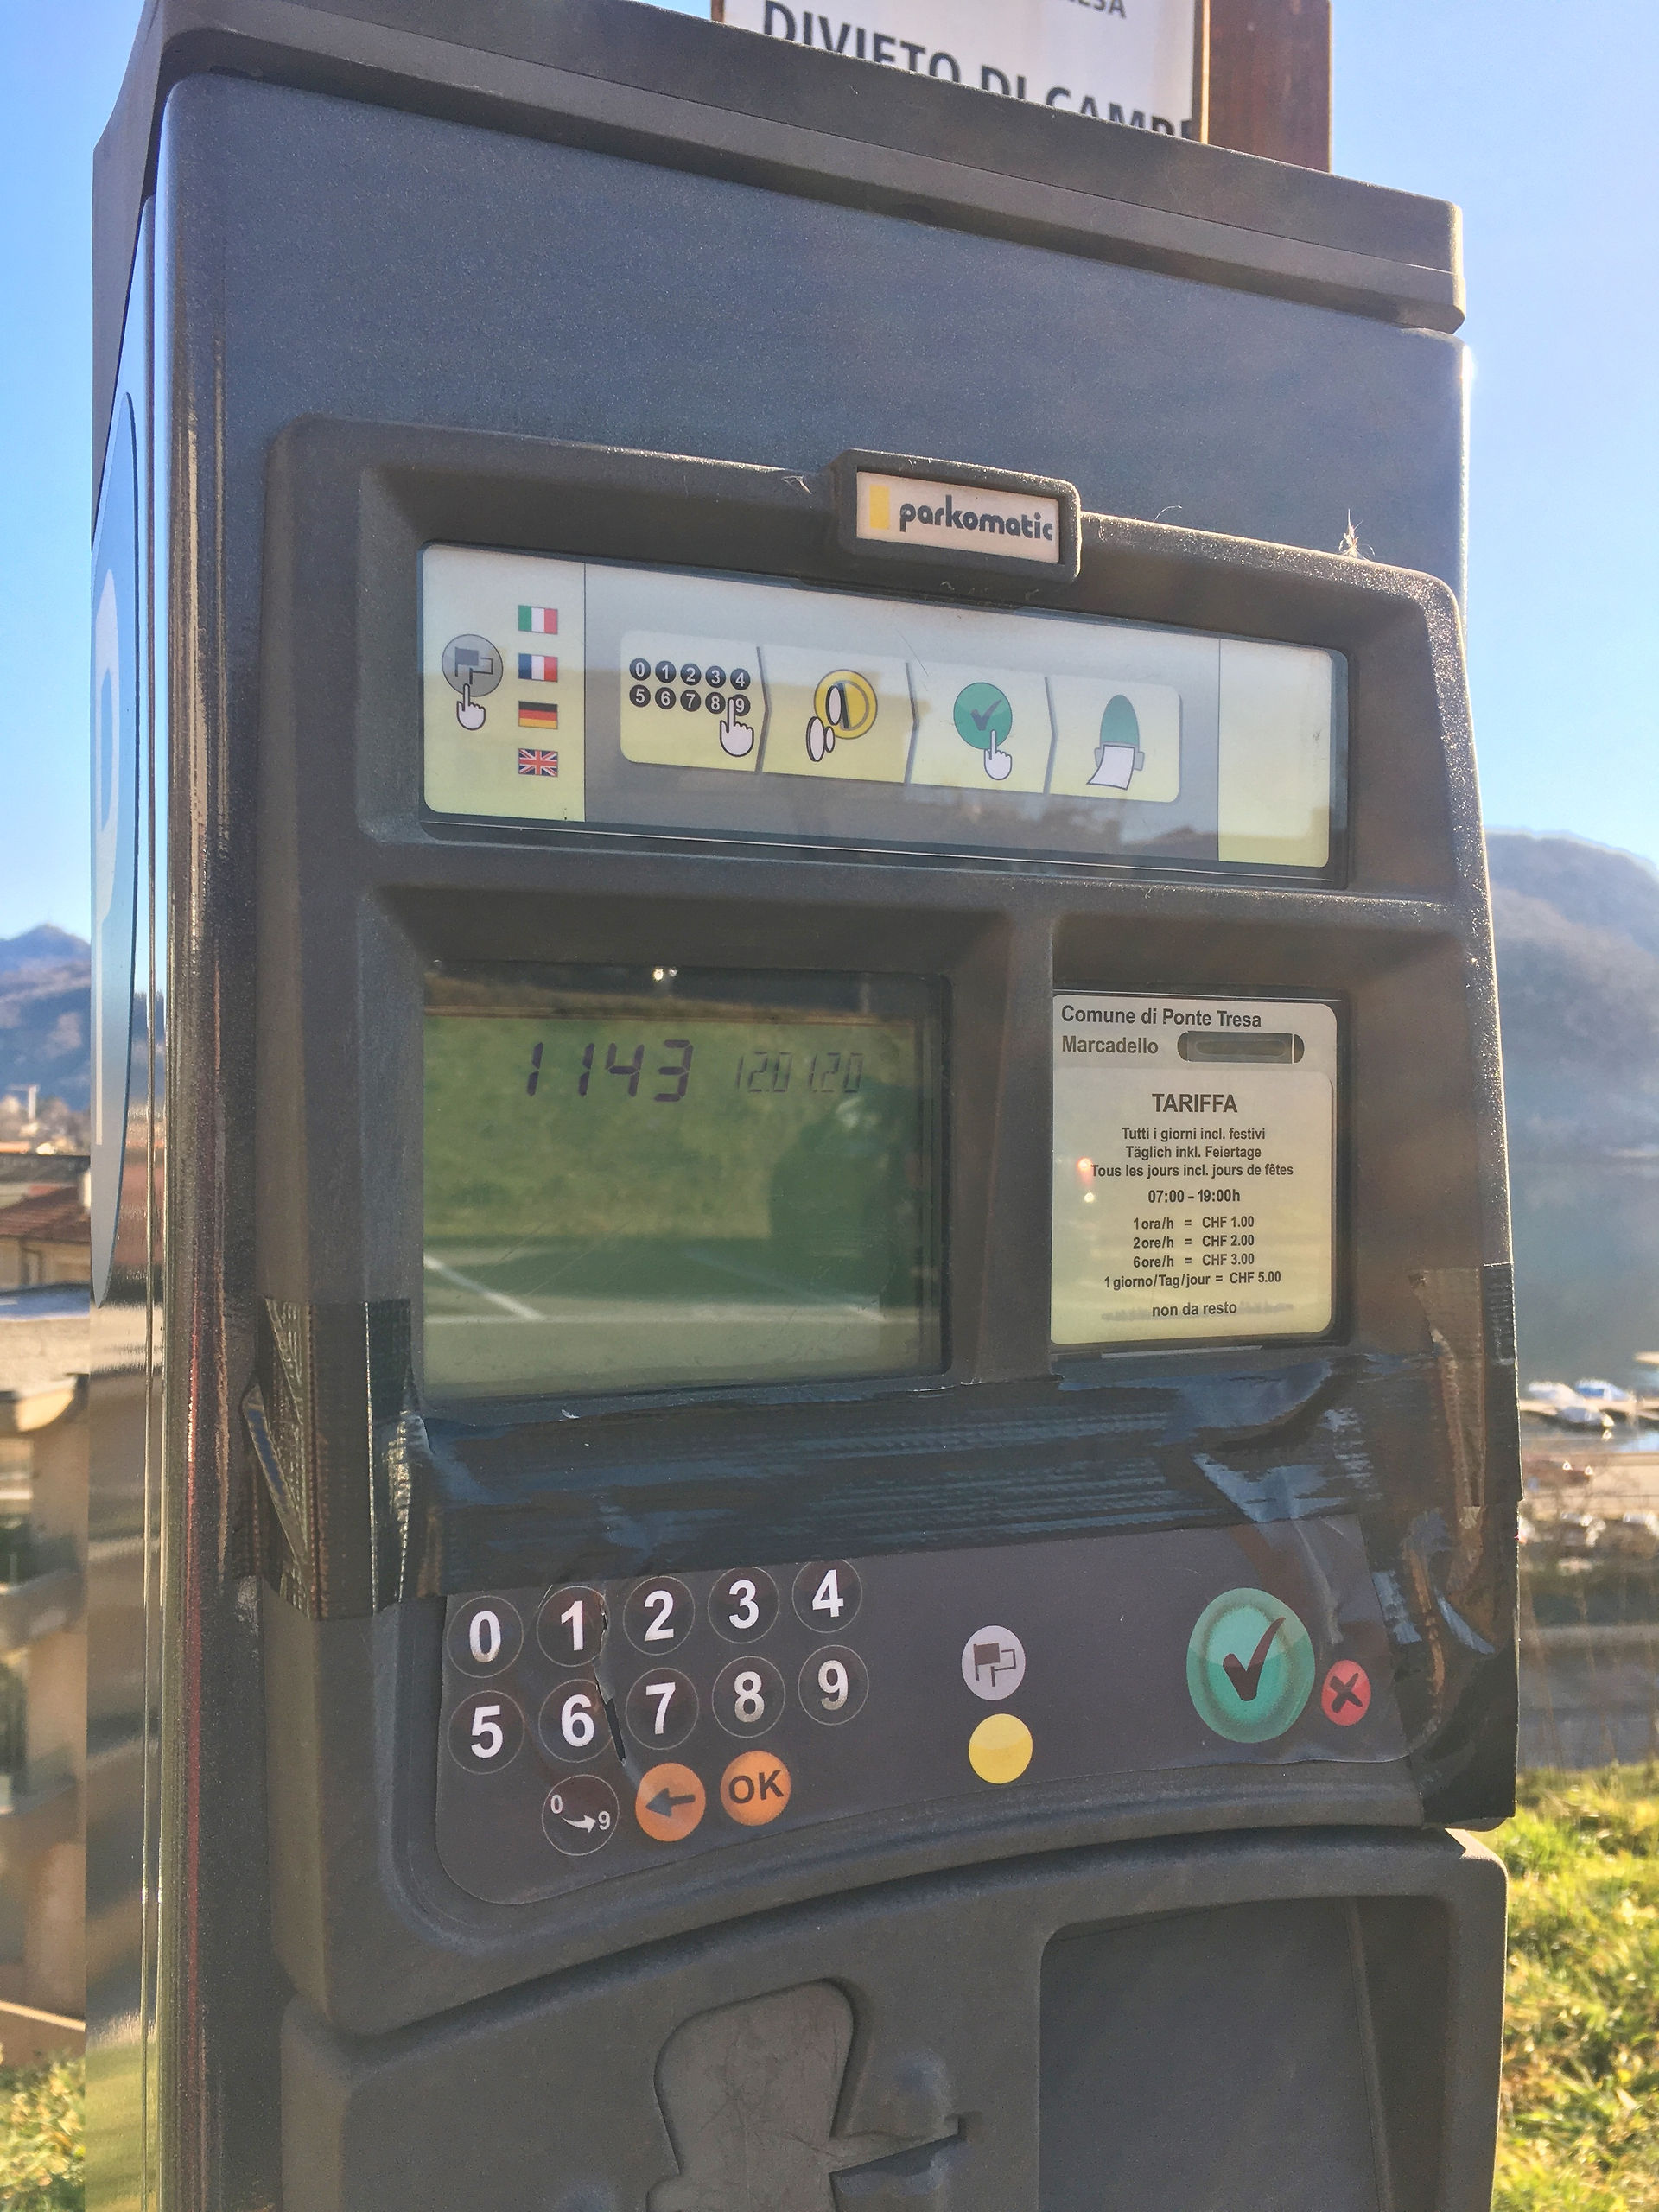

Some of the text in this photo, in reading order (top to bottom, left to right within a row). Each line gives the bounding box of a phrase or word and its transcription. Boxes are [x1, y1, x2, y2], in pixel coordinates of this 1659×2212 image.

[899, 494, 1052, 541] parkomatic
[635, 662, 745, 687] 0 1 2 3 4
[635, 689, 745, 713] 5 6 7 8 9
[1061, 1005, 1262, 1027] Comune di Ponte Tresa
[1062, 1035, 1159, 1054] Marcadello
[1152, 1093, 1238, 1113] TARIFFA
[1122, 1128, 1265, 1142] Tutti i giorni incl. festivi
[1126, 1146, 1262, 1160] Täglich inkl. Feiertage
[1091, 1163, 1294, 1179] Tous les jours incl. jours de fêtes
[1147, 1190, 1185, 1203] 07:00
[1202, 1216, 1227, 1228] CHF
[1230, 1216, 1255, 1228] 1.00
[1202, 1235, 1227, 1247] CHF
[1230, 1234, 1255, 1246] 2.00
[1202, 1254, 1227, 1266] CHF
[1230, 1253, 1255, 1265] 3.00
[1230, 1272, 1255, 1284] CHF
[1258, 1271, 1281, 1283] 5.00
[1152, 1302, 1237, 1317] non da resto
[469, 1569, 844, 1663] 0 1 2 3 4
[470, 1660, 848, 1758] 5 6 7 8 9
[728, 1770, 785, 1806] OK
[550, 1794, 611, 1830] 0 9
